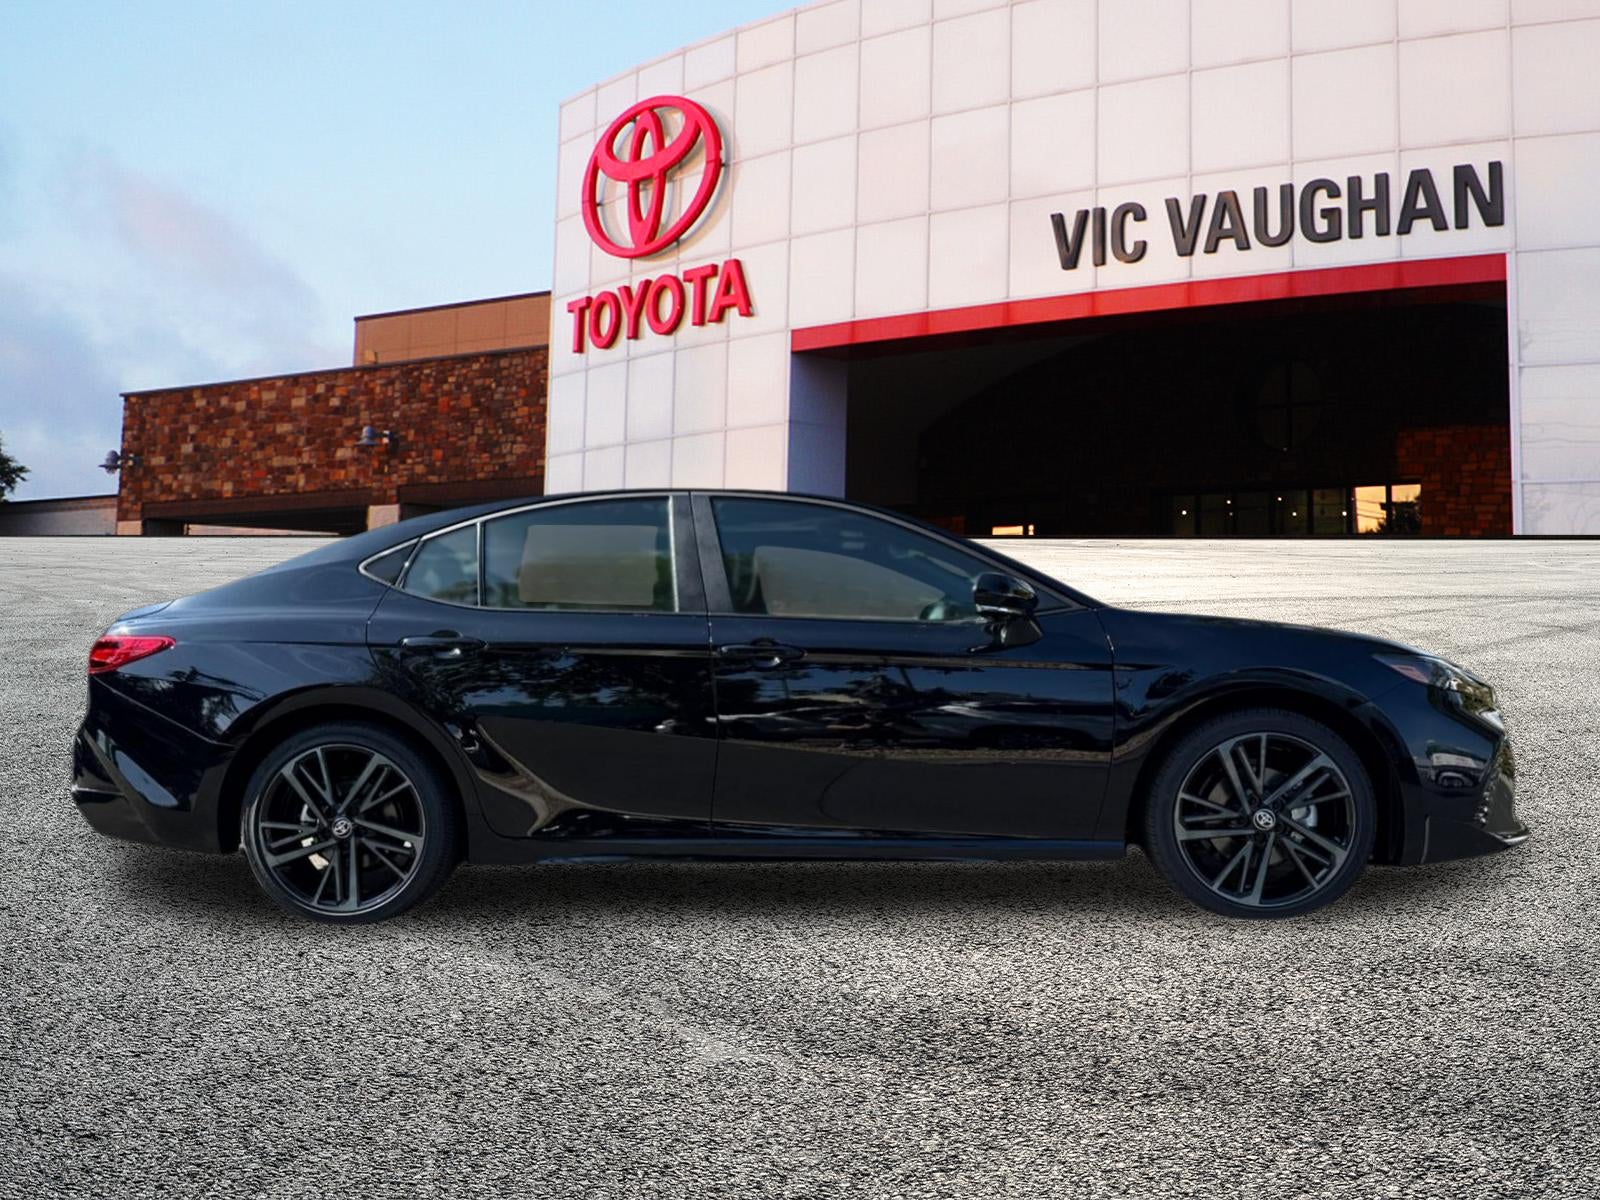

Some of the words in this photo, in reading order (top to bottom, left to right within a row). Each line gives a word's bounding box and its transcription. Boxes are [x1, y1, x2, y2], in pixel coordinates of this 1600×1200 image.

[1051, 202, 1147, 270] VIC
[1165, 161, 1504, 257] VAUGHAN
[567, 258, 753, 353] TOYOTA
